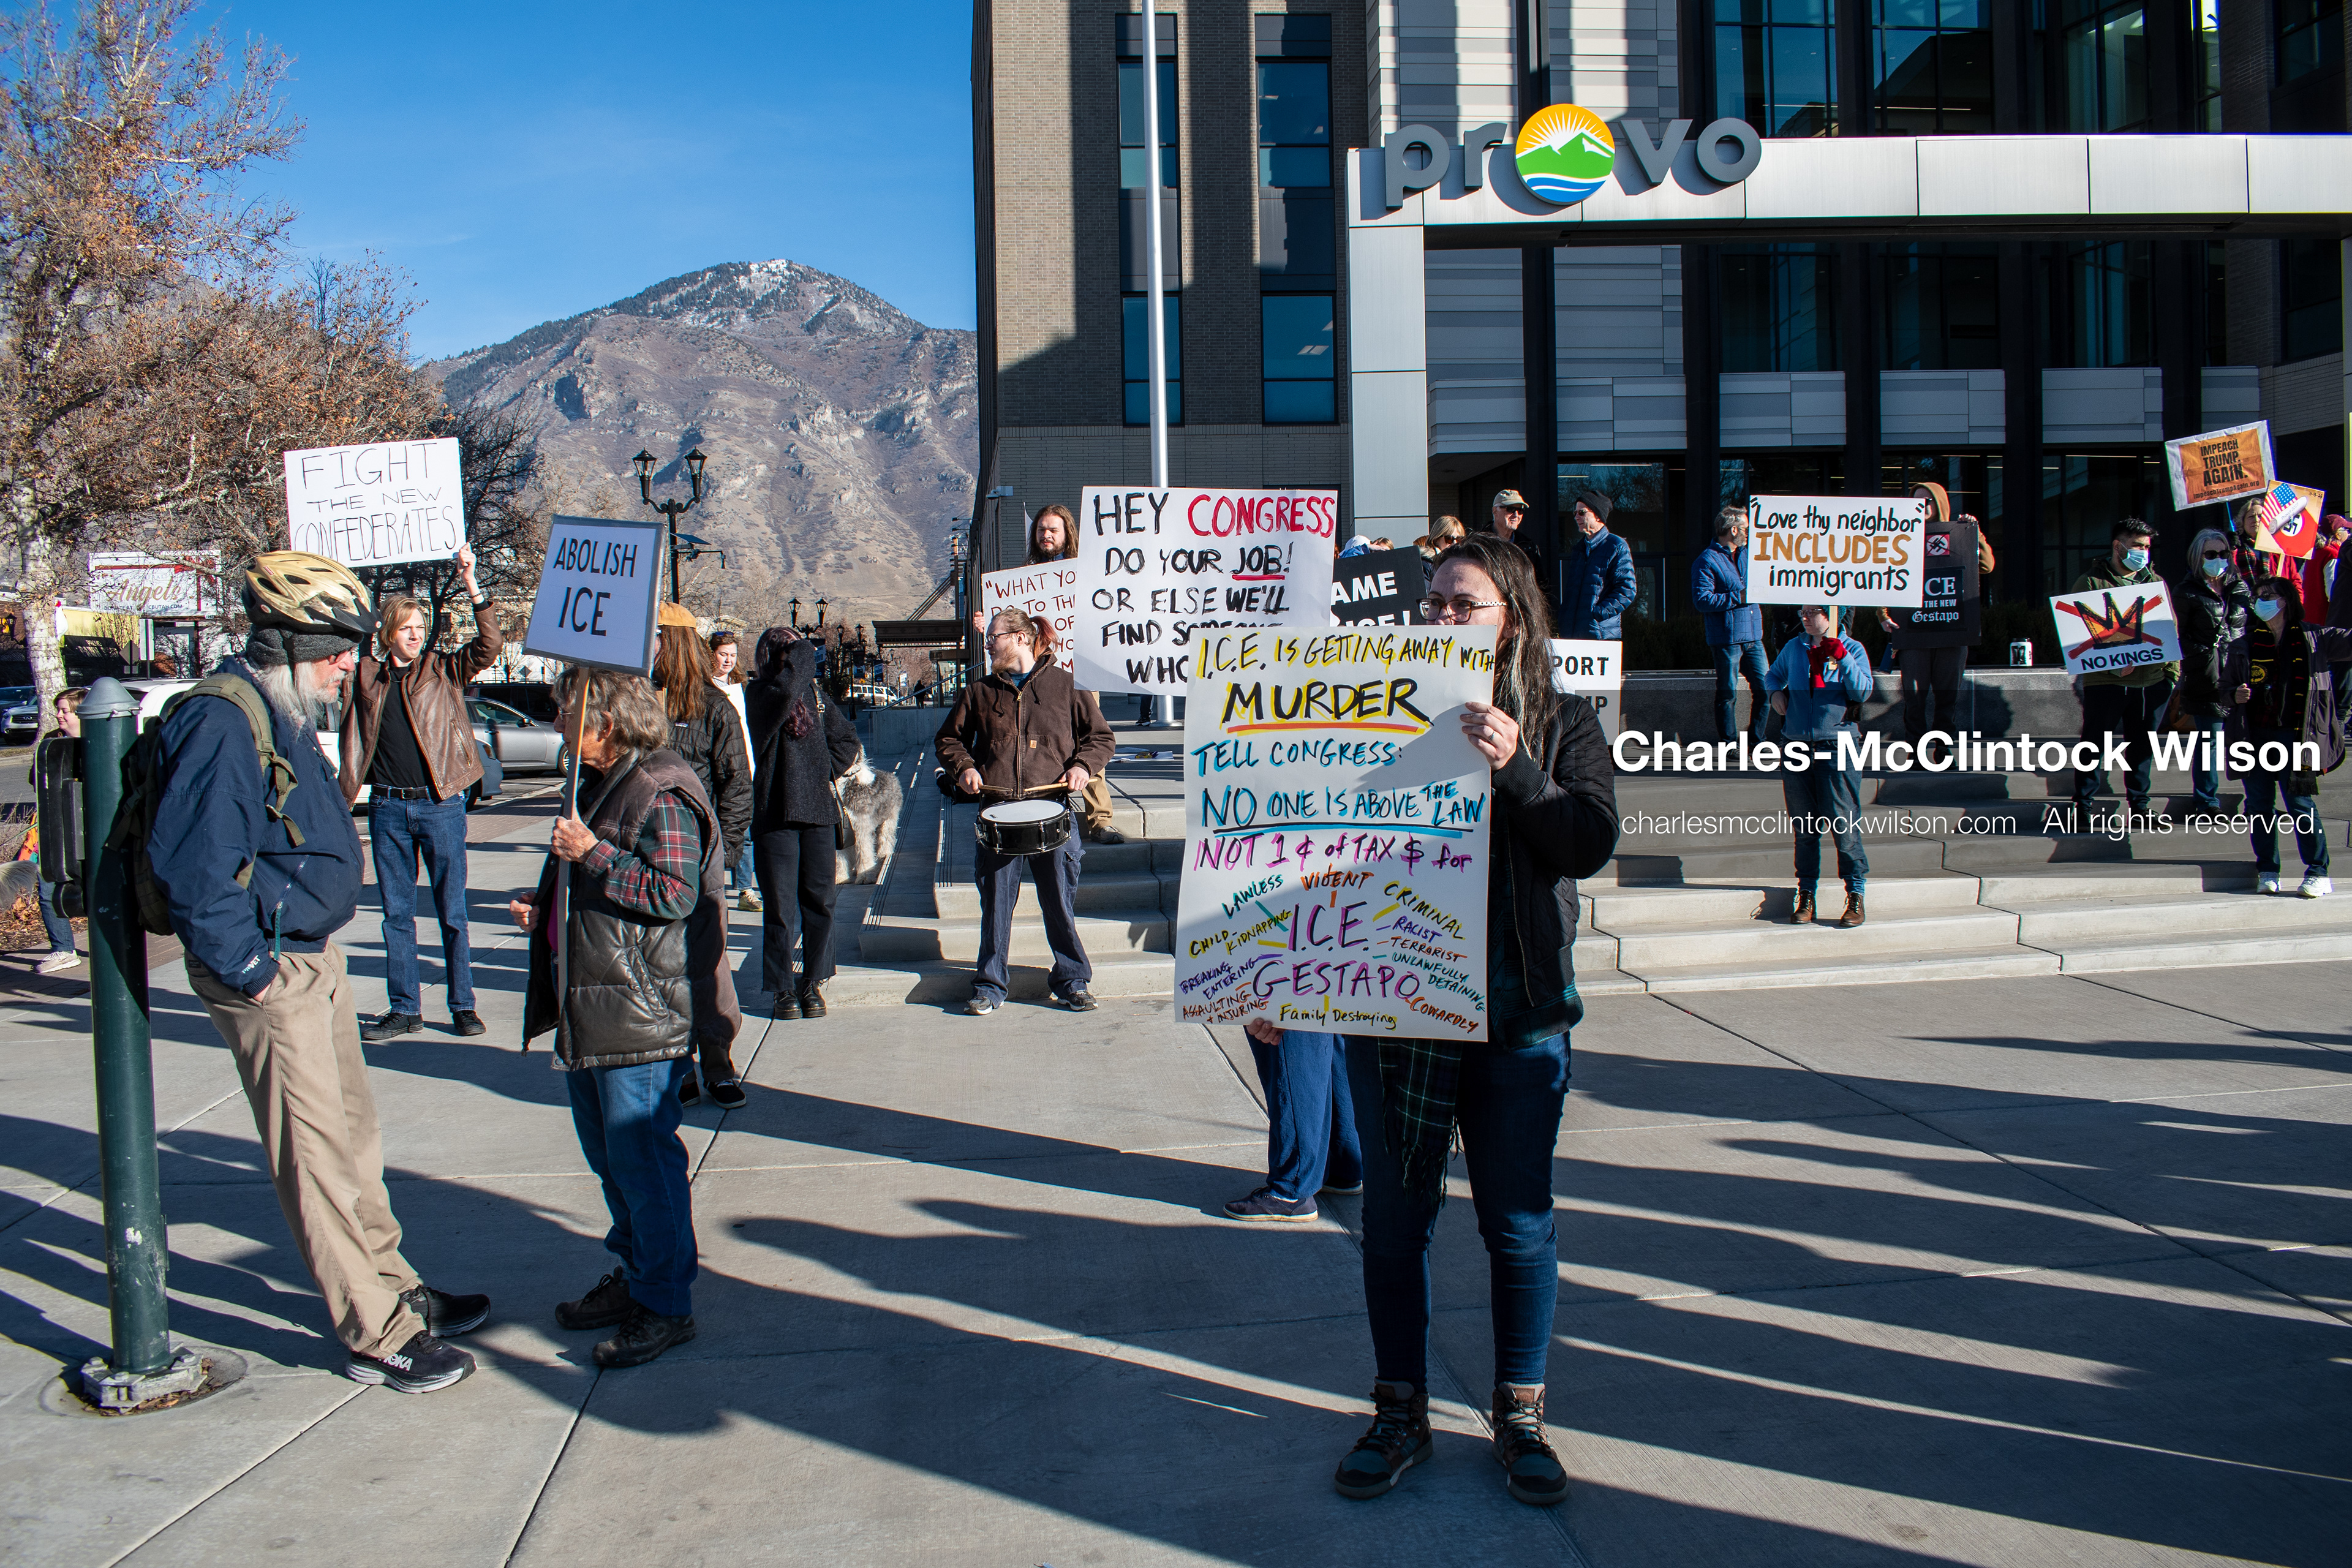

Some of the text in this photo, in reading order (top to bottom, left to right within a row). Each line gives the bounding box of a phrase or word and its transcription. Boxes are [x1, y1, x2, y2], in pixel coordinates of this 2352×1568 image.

[2201, 439, 2239, 456] IMPEACH
[2203, 451, 2241, 469] TRUMP.
[302, 443, 437, 489] FIGHT
[2203, 463, 2248, 487] AGAIN.
[306, 487, 442, 513] THE NEW
[1093, 492, 1335, 538] HEY CONGRESS
[294, 505, 456, 562] CONFEDERATES
[1803, 505, 1830, 536] thy
[553, 537, 638, 578] ABOLISH
[1104, 541, 1294, 576] DO YOUR JOB!
[1754, 532, 1912, 566] INCLUDES
[107, 578, 181, 606] Angels
[1769, 565, 1910, 597] immigrants
[558, 586, 611, 636] ICE
[1023, 599, 1046, 615] TO
[1091, 585, 1289, 615] OR ELSE WE'LL
[1912, 611, 1959, 623] Gestapo
[1940, 599, 1957, 608] NEW
[1100, 620, 1163, 648] FIND
[1197, 632, 1267, 679] I.C.E.
[1275, 636, 1298, 666] IS
[1400, 635, 1456, 668] AWAY
[1460, 646, 1495, 673] WITH
[2081, 648, 2165, 671] NO KINGS
[1220, 677, 1434, 728] MURDER
[1191, 738, 1259, 777] TELL
[1202, 780, 1486, 827] NO ONE IS ABOVE THE LAW
[1194, 832, 1265, 871] NOT
[1265, 832, 1290, 868] 1
[1324, 832, 1349, 859] of
[1351, 832, 1396, 867] TAX
[1400, 831, 1425, 876] $
[1431, 842, 1472, 873] for
[1221, 874, 1284, 919] LAWLESS
[1384, 880, 1466, 940] CRIMINAL
[1225, 909, 1293, 955] KIDNAPPING
[1287, 901, 1370, 952] I.C.E.
[1392, 916, 1442, 943] RACIST
[1390, 936, 1468, 962] TERRORIST
[1202, 958, 1257, 1000] ENTERING
[1253, 959, 1420, 1001] GESTAPO
[1392, 952, 1470, 982] UNLAWFULLY
[1182, 990, 1252, 1020] ASSAULTING
[1428, 973, 1486, 1012] DETAINING
[1217, 998, 1270, 1023] INJURING
[1280, 1003, 1398, 1031] Family Destroying
[1409, 997, 1479, 1034] COWARDLY
